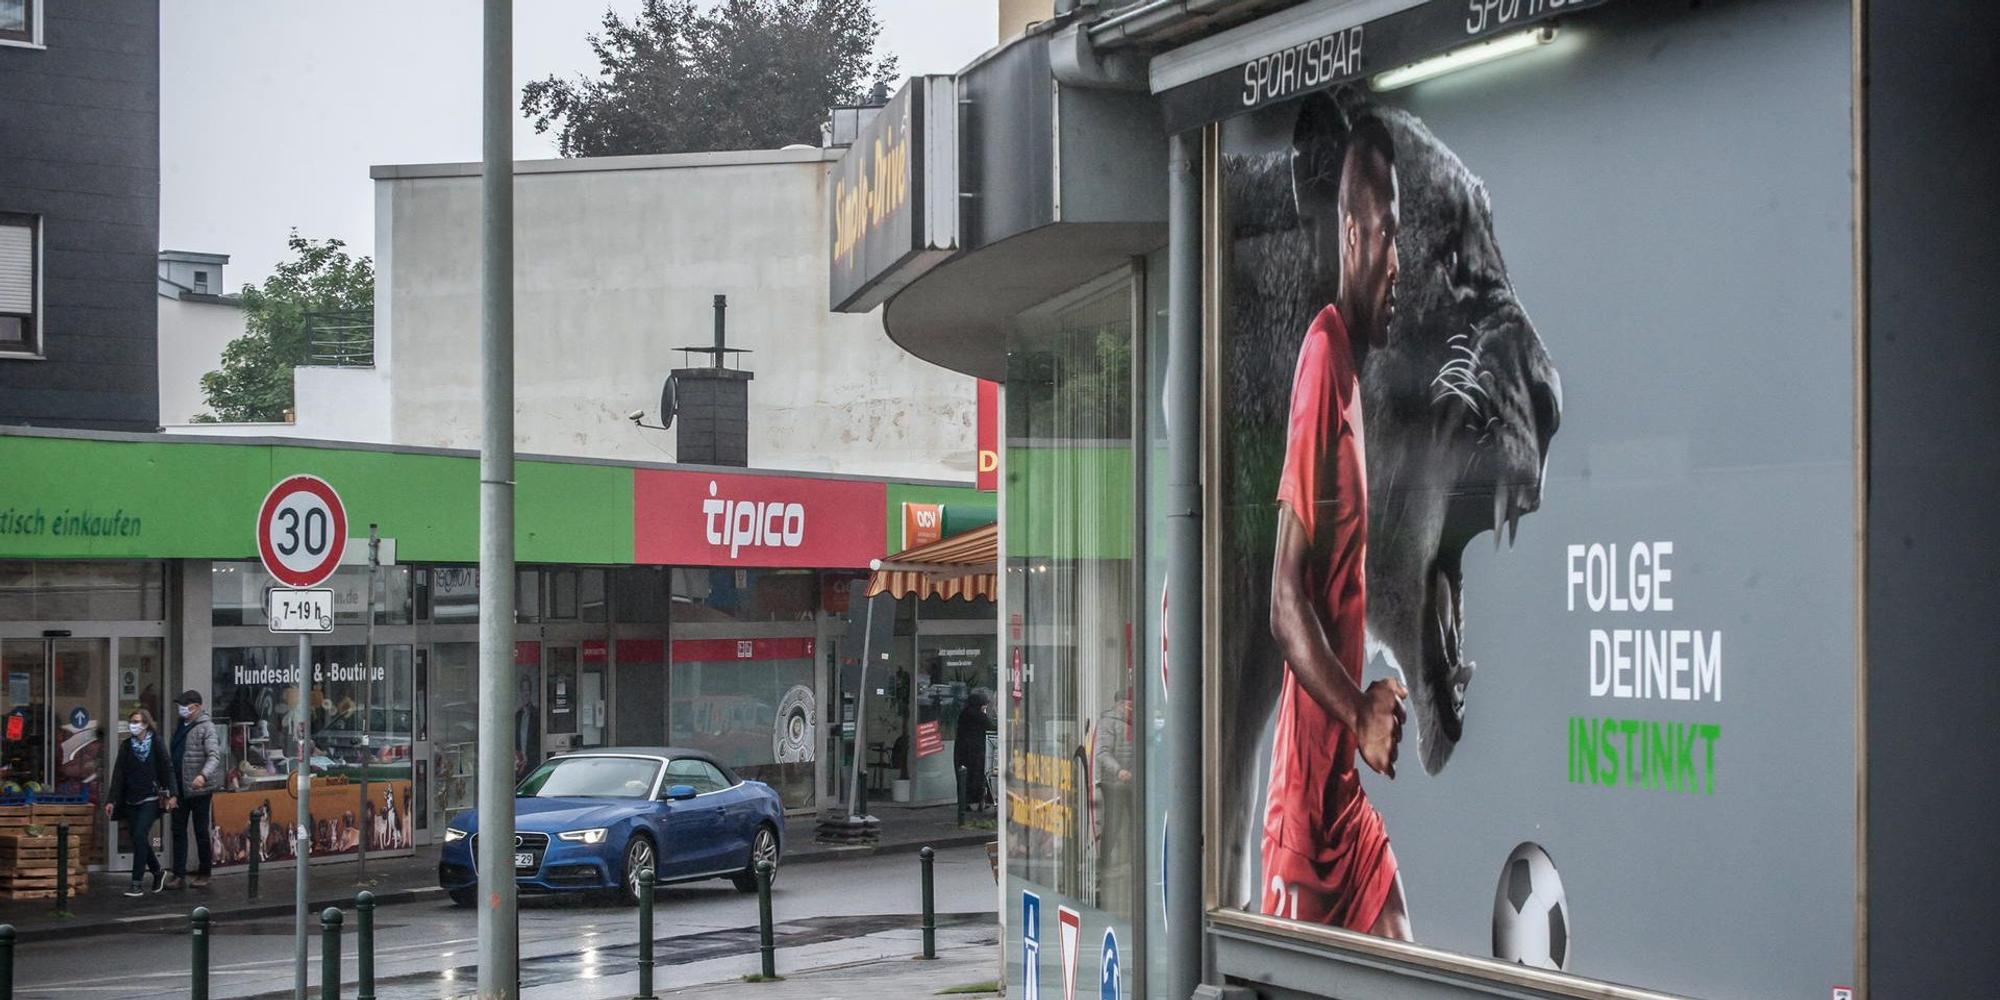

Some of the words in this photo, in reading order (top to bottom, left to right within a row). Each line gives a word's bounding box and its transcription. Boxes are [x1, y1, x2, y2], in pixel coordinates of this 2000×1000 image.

[1243, 25, 1363, 106] SPORTSBAR
[52, 508, 141, 537] einkaufen
[277, 507, 327, 556] 30
[703, 480, 805, 559] tipico
[1567, 541, 1673, 612] FOLGE
[314, 601, 321, 620] h
[234, 664, 301, 685] Hundesalo
[314, 663, 323, 682] &
[1589, 629, 1722, 702] DEINEM
[1567, 716, 1721, 795] INSTINKT
[1271, 874, 1298, 920] 21
